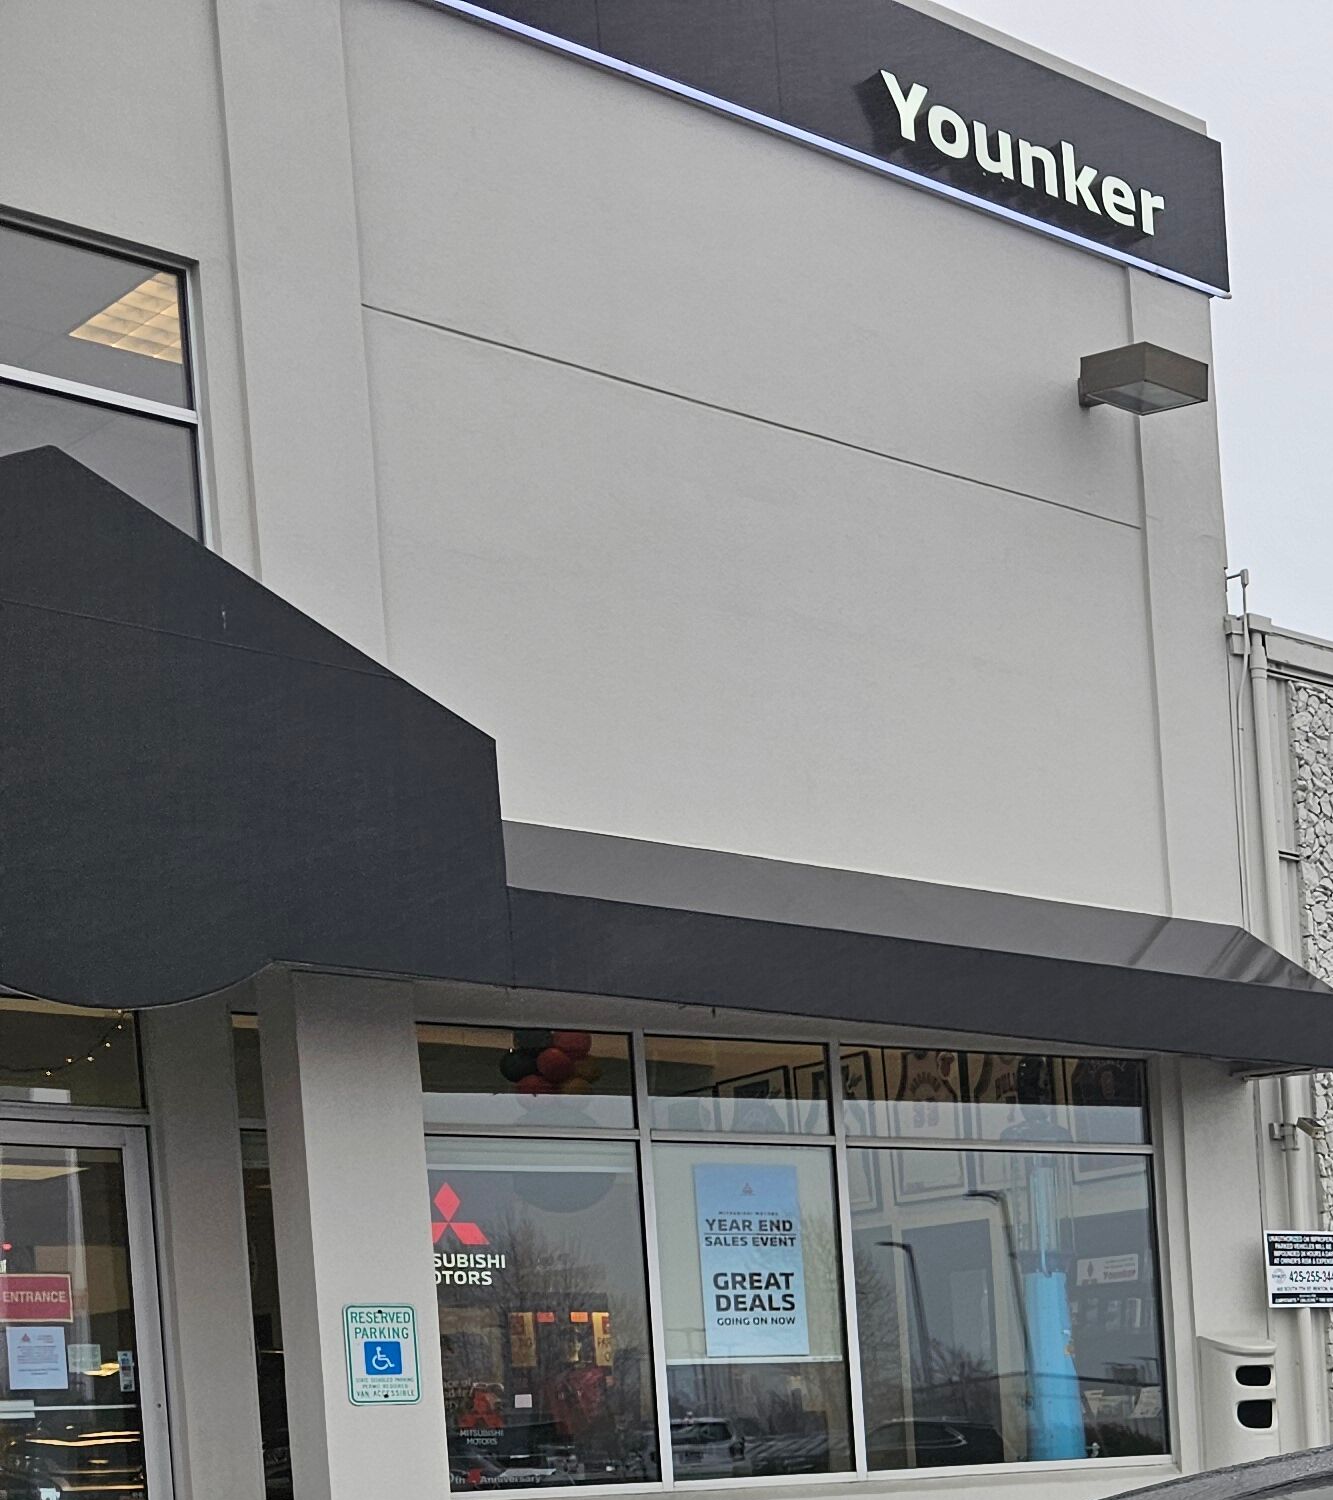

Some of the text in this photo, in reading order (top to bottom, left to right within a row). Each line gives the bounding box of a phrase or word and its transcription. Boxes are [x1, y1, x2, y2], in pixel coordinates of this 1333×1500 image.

[880, 69, 1165, 236] Younker
[705, 1219, 793, 1232] YEAR END
[704, 1236, 797, 1247] SALES EVENT
[713, 1272, 795, 1290] GREAT
[3, 1291, 67, 1303] ENTRANCE
[715, 1293, 796, 1312] DEALS
[350, 1311, 411, 1324] RESERVED
[717, 1317, 796, 1326] GOING ON NOW
[354, 1327, 409, 1339] PARKING
